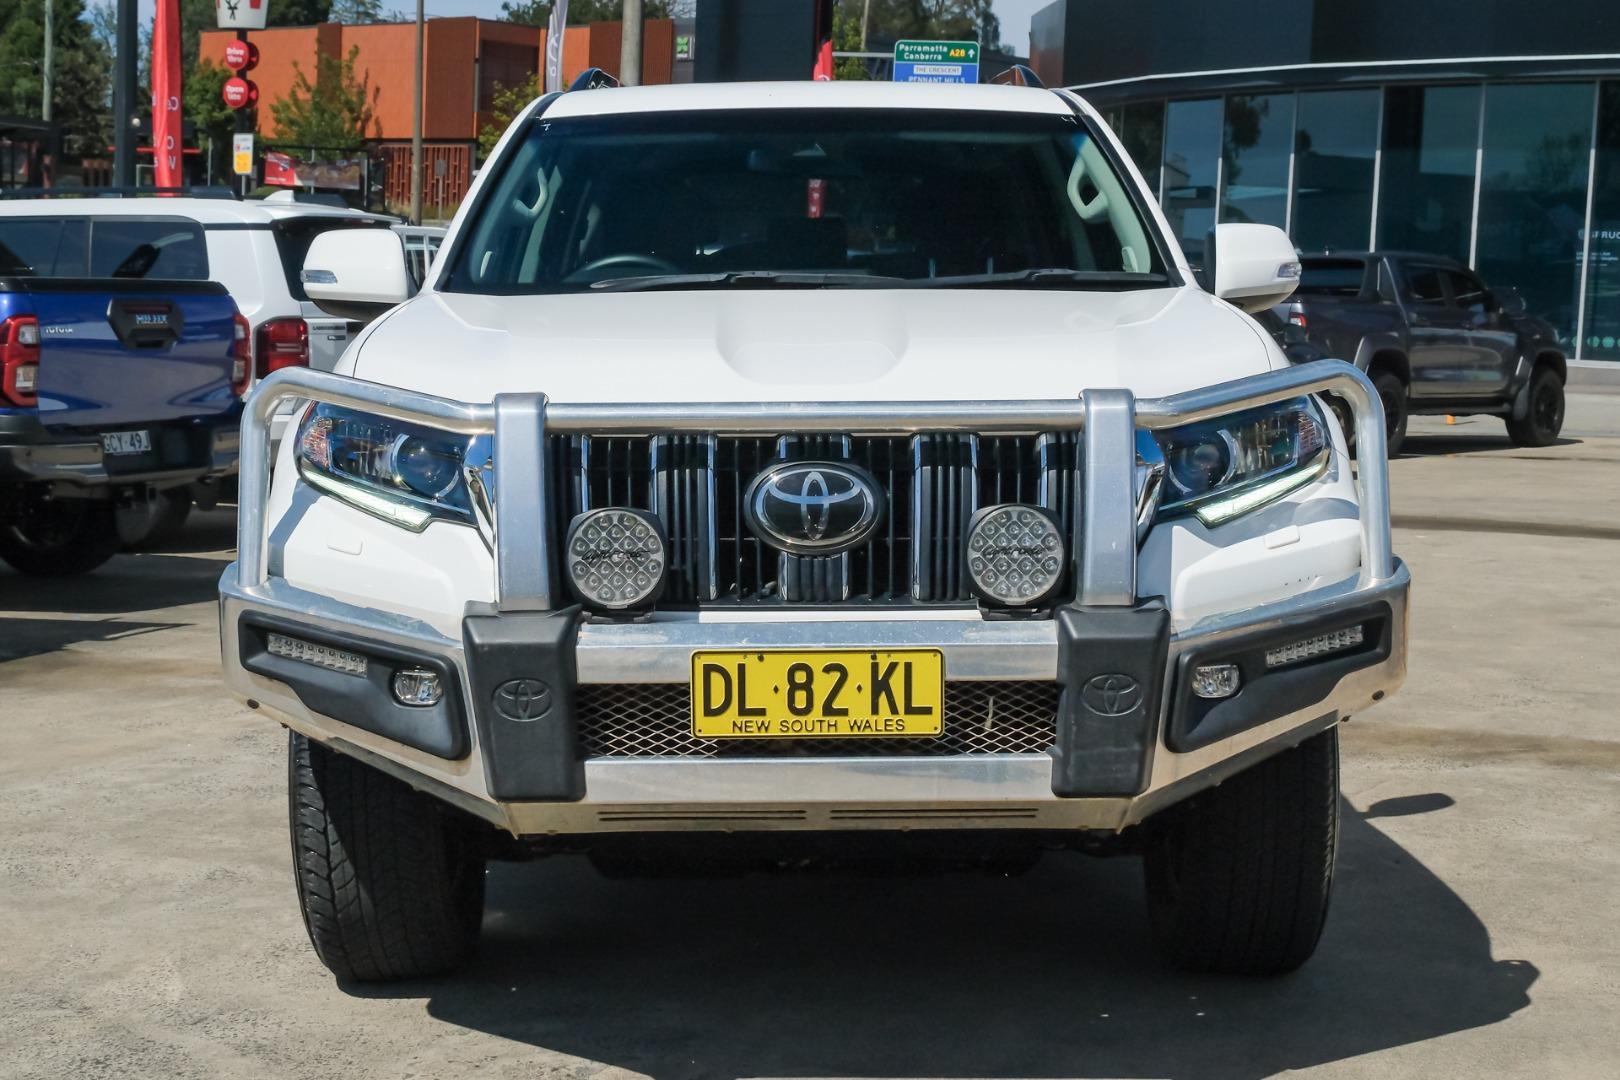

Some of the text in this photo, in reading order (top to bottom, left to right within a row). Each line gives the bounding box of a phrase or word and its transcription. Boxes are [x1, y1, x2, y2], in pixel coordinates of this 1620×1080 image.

[226, 47, 245, 56] Drive
[899, 43, 948, 53] Parramatta
[903, 52, 943, 61] Canberra
[928, 67, 960, 75] CRESCENT
[226, 85, 245, 95] Open
[732, 718, 906, 733] NEW SOUTH WALES
